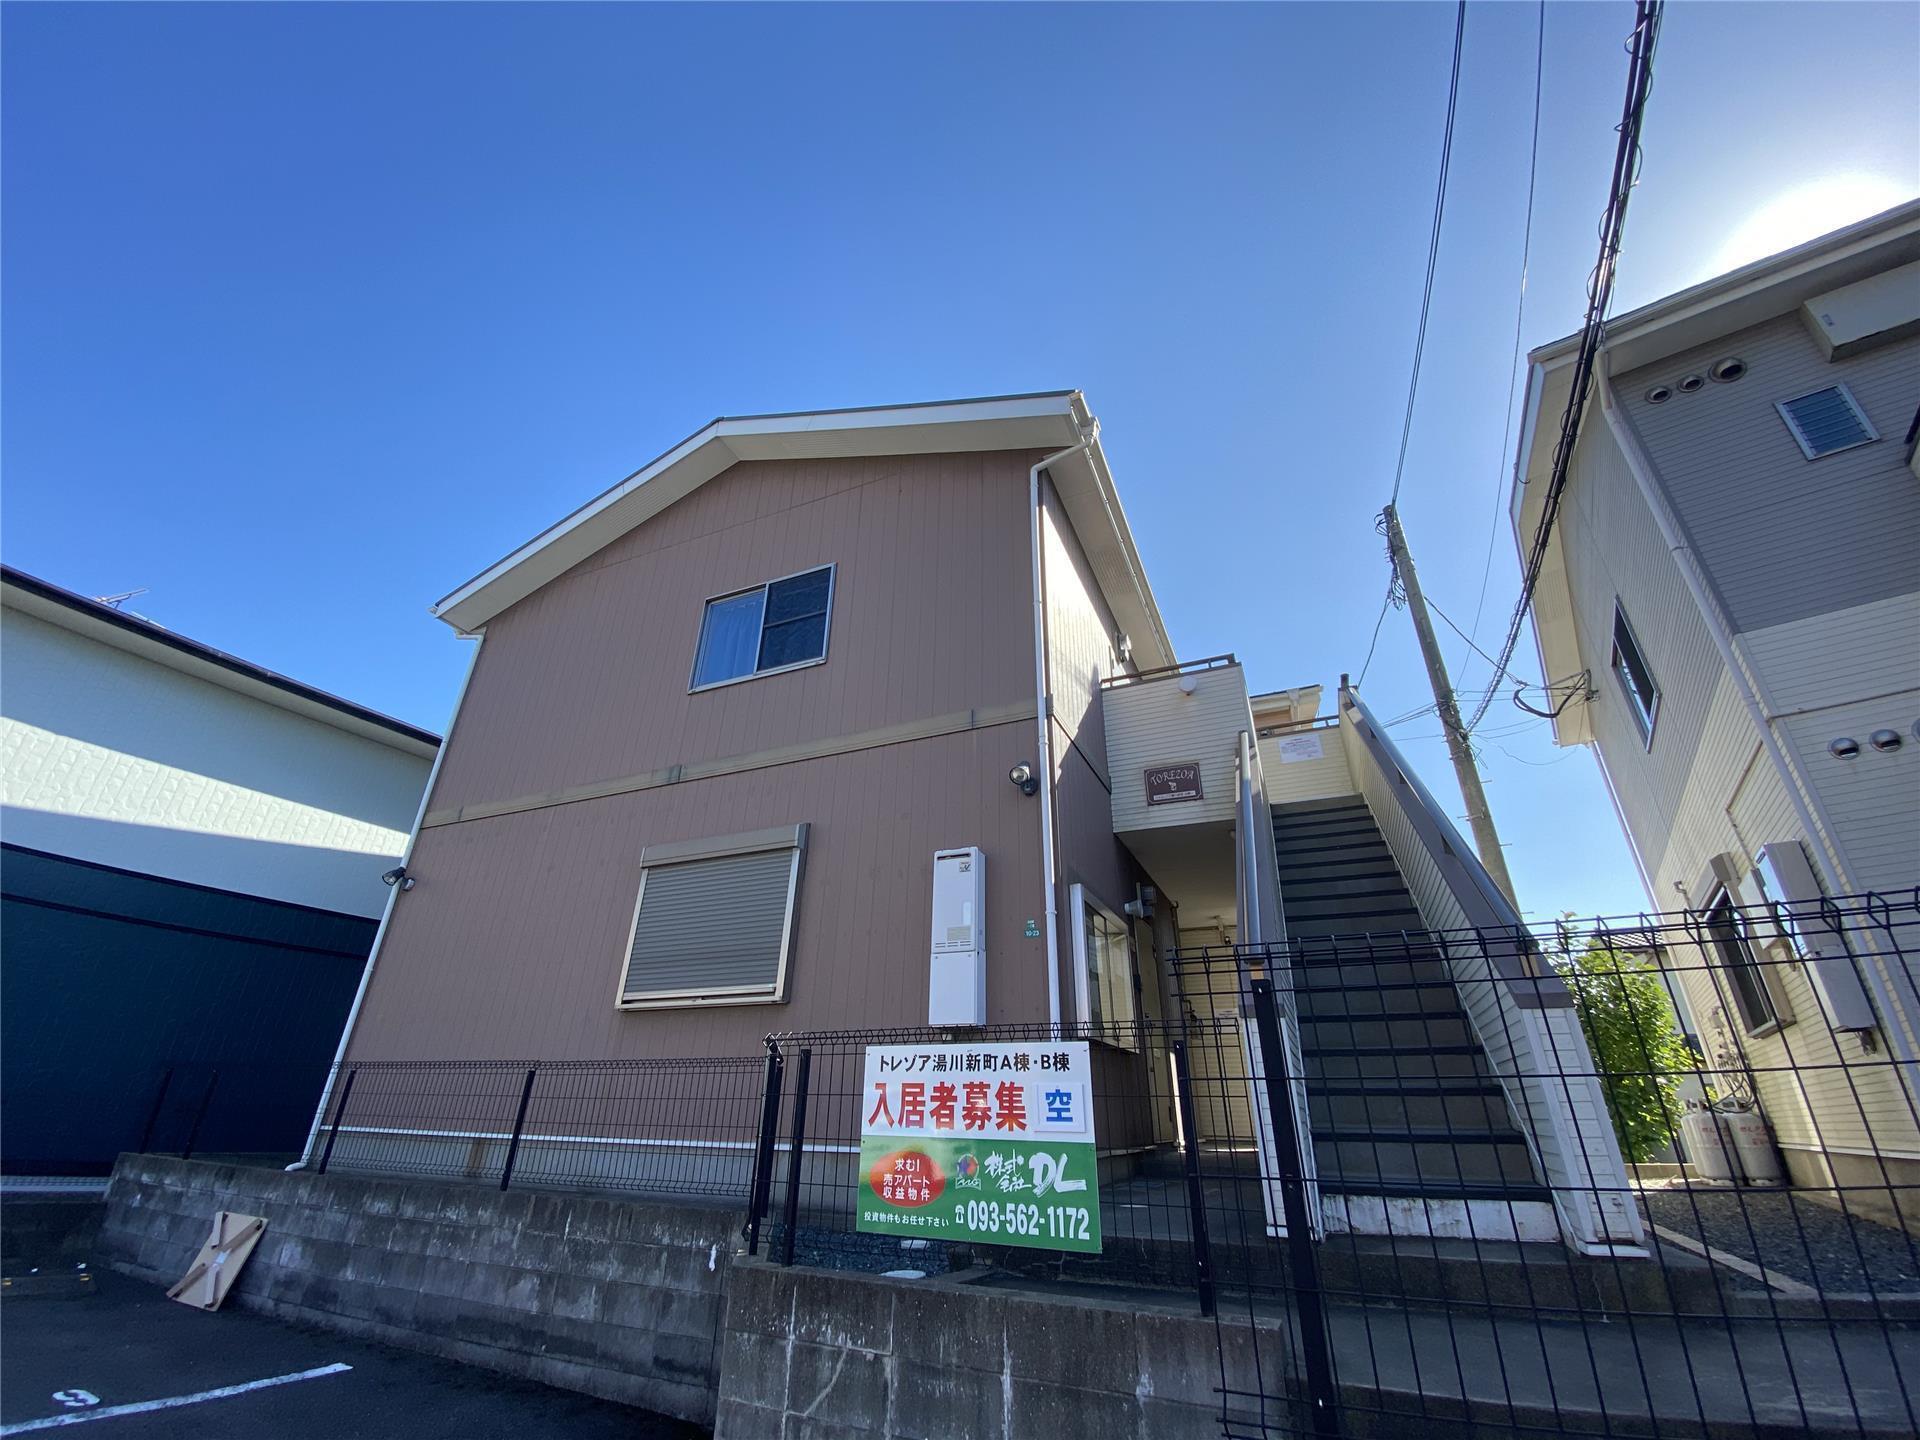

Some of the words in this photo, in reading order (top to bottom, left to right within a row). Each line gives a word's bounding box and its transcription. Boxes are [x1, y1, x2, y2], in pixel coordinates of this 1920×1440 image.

[868, 1081, 1028, 1132] 入居者募集
[1044, 1089, 1073, 1123] 空
[883, 1174, 930, 1188] 売アパート
[1029, 1152, 1087, 1198] DL
[883, 1186, 930, 1201] 収益物件
[864, 1211, 950, 1227] 投資物件もお任せ下さい
[967, 1199, 1090, 1240] 093-562-1172
